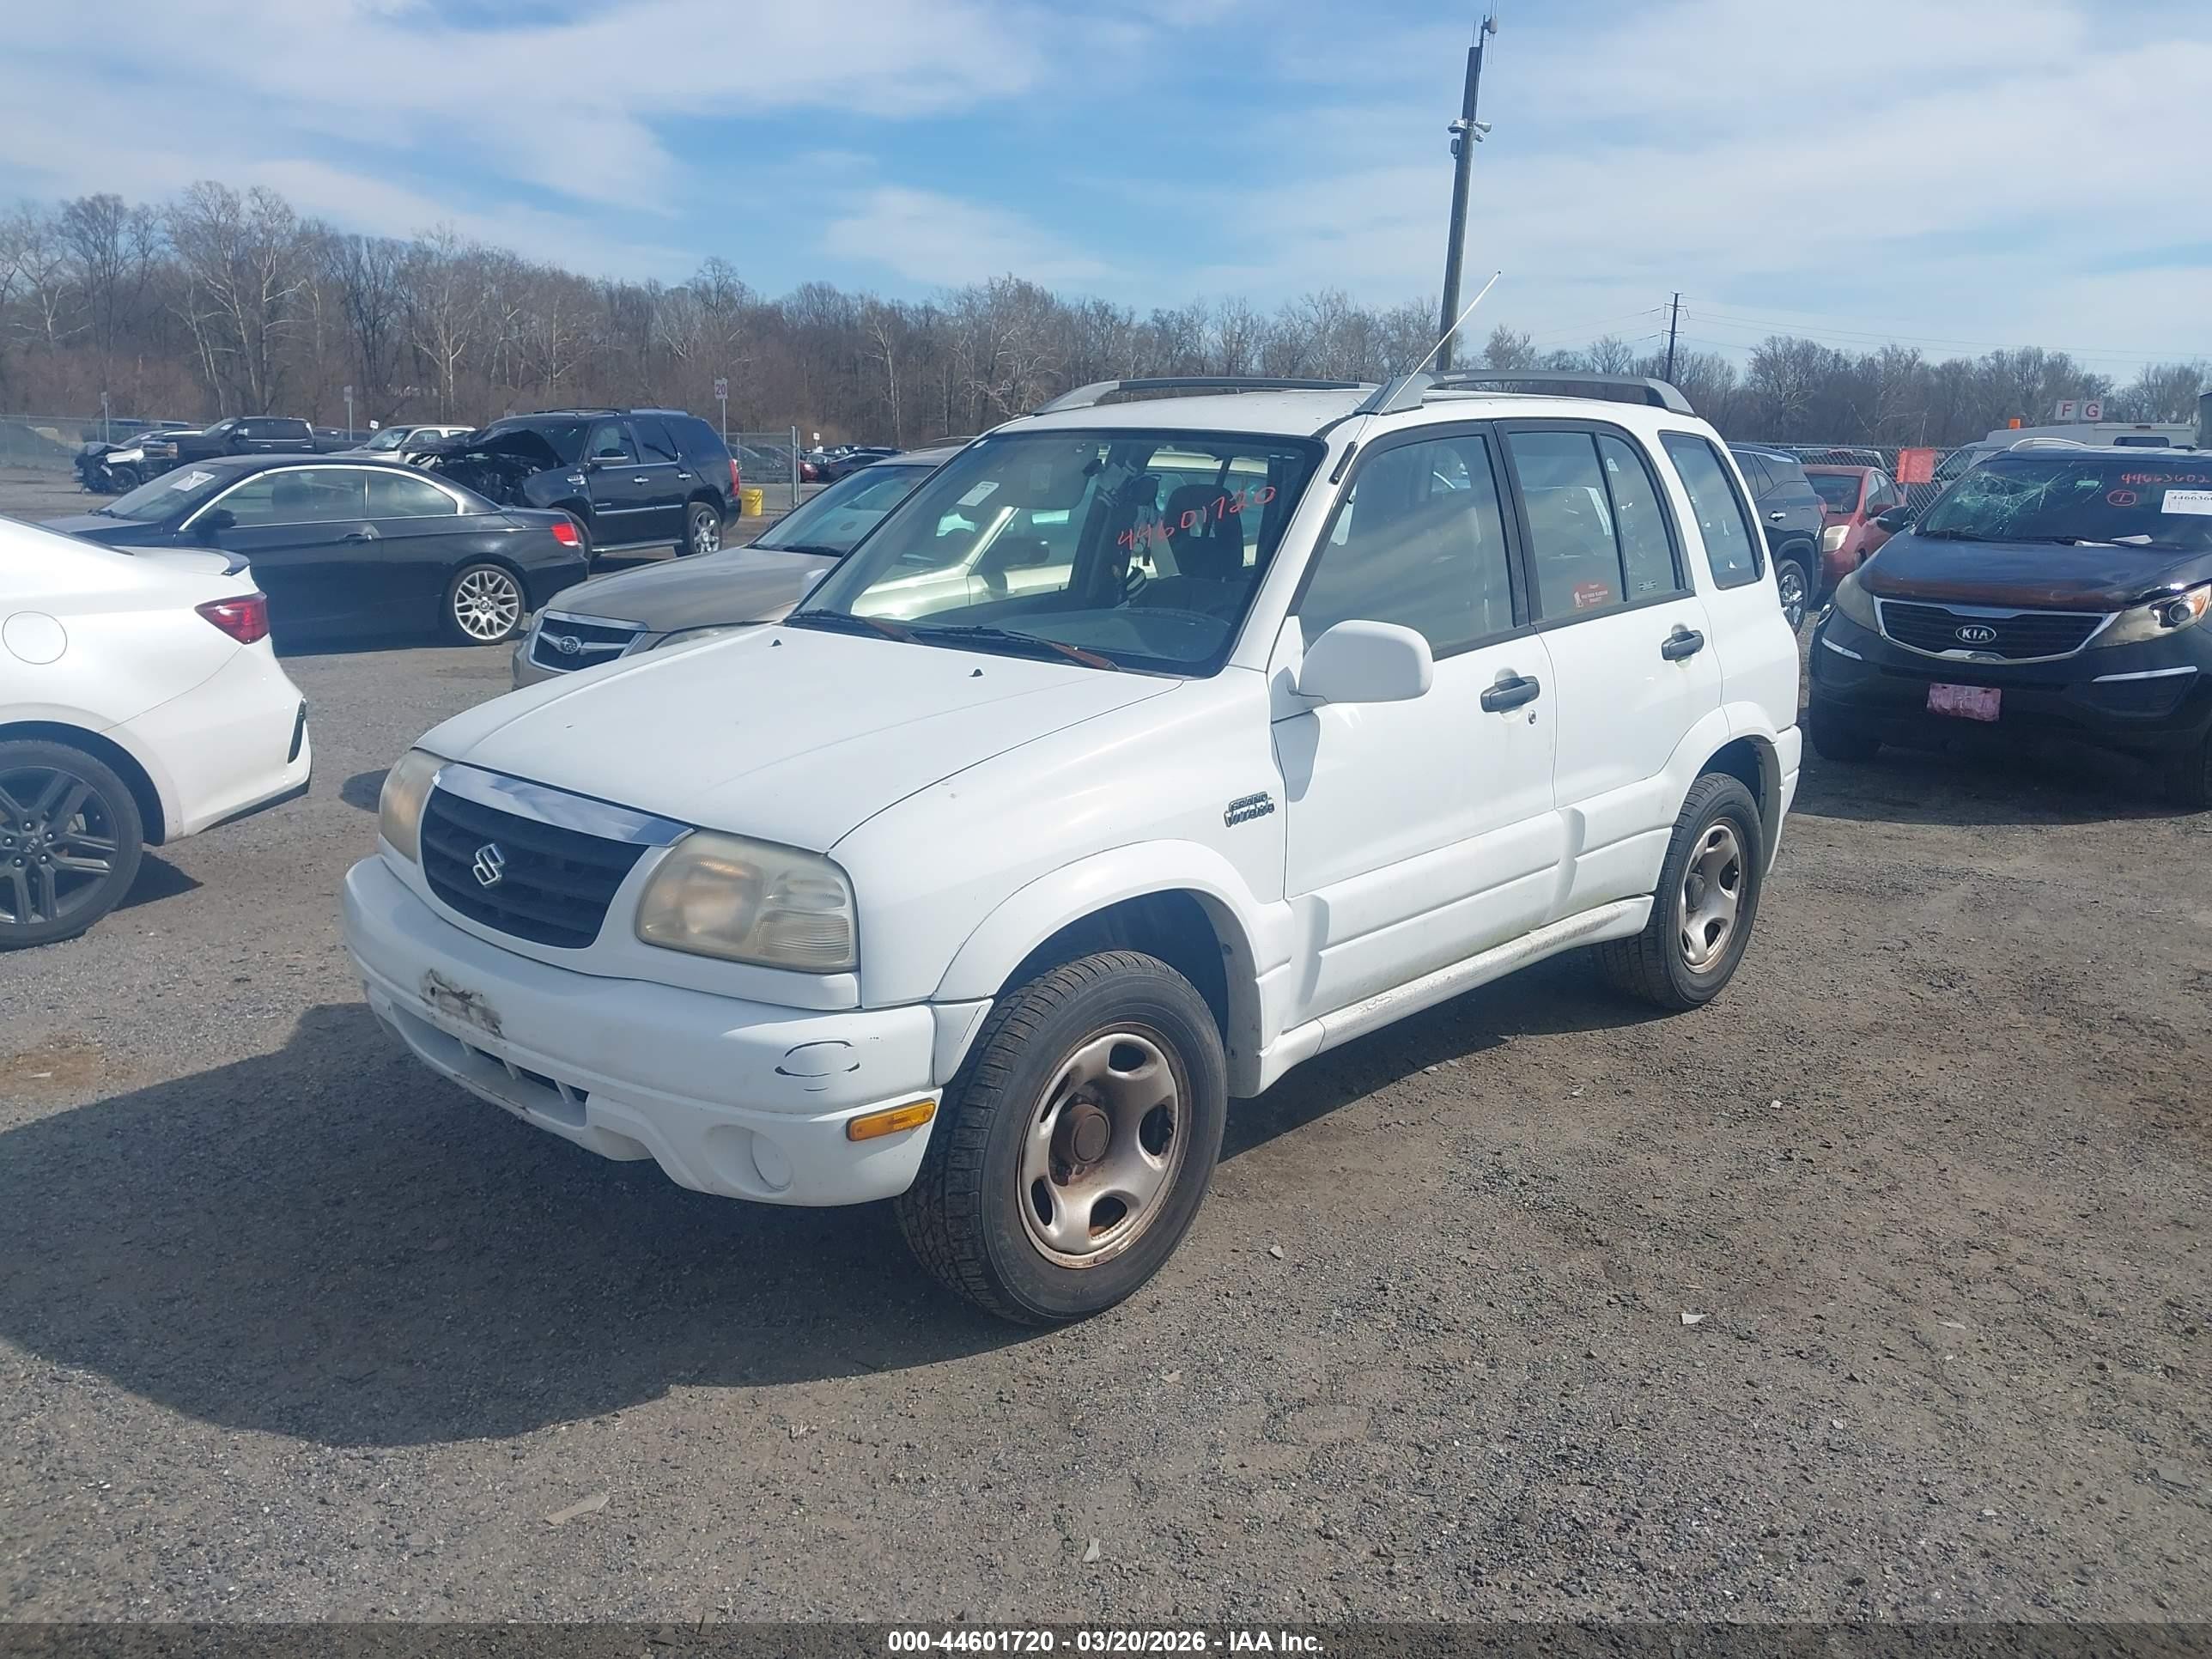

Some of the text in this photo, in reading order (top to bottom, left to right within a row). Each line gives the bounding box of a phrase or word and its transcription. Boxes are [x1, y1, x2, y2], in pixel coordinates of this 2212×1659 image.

[715, 383, 726, 395] 20
[2062, 404, 2073, 417] F
[2085, 404, 2099, 417] G
[1961, 628, 1989, 640] KIA
